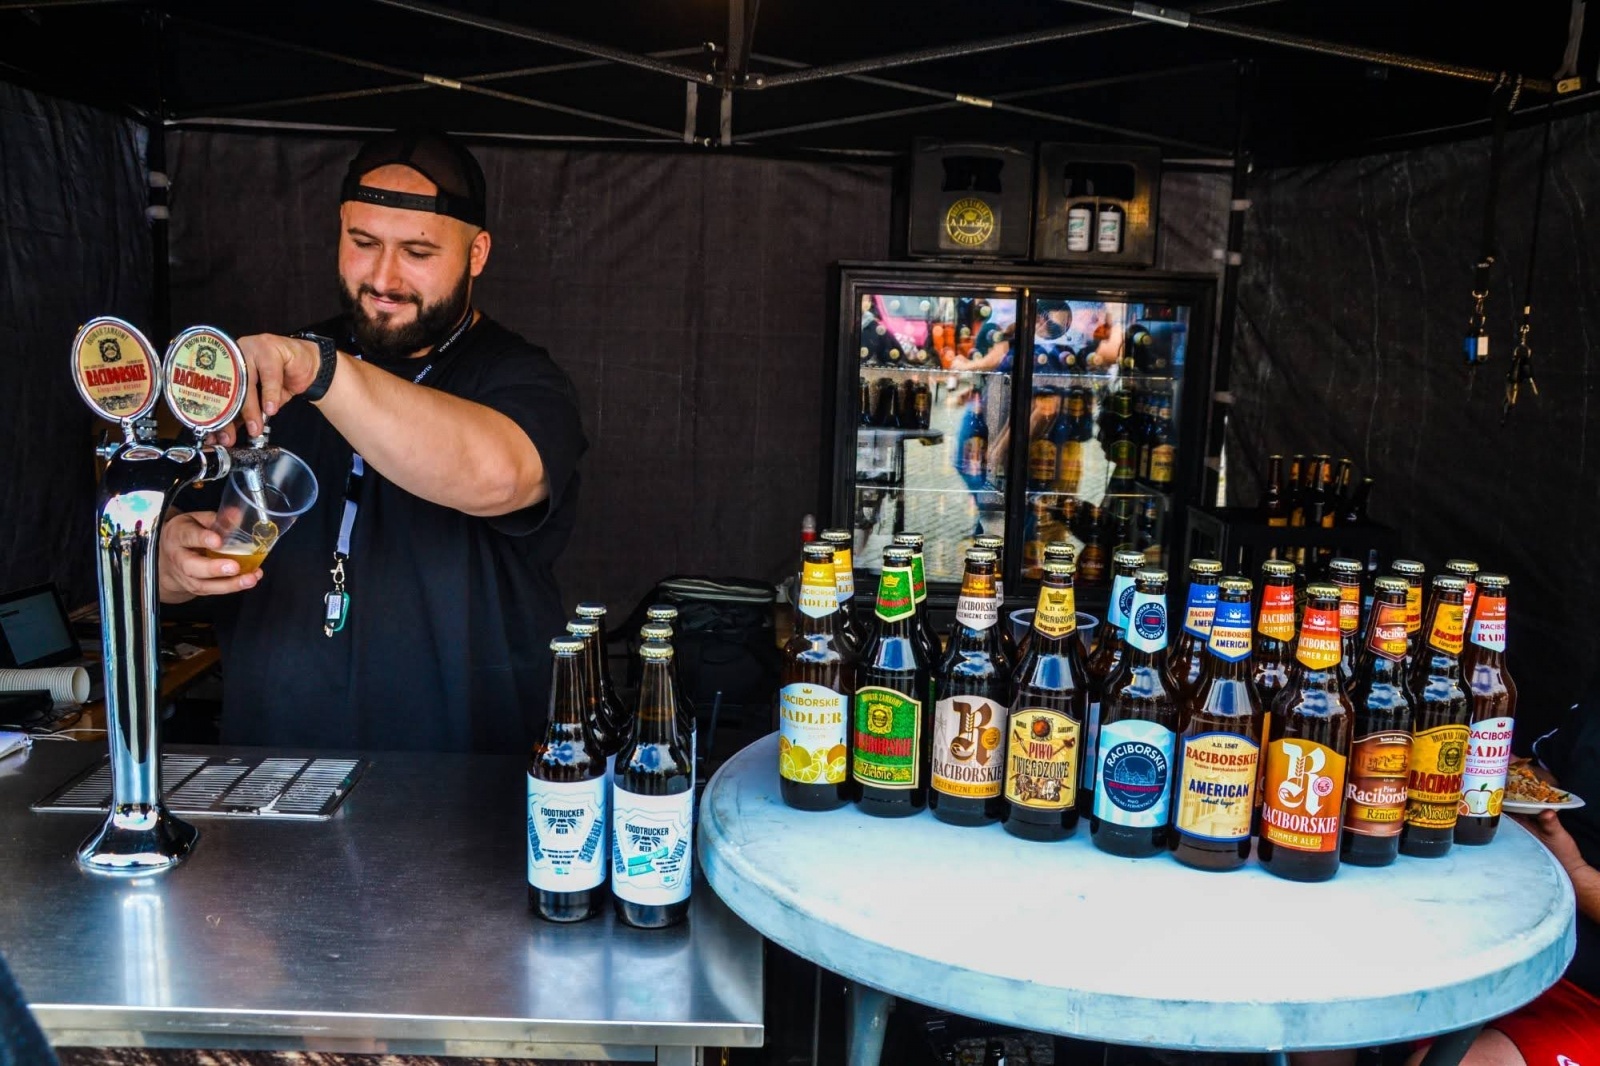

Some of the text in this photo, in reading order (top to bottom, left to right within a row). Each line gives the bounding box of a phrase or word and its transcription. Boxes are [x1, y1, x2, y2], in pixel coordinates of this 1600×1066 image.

[173, 367, 231, 399] RACIBORSKIE
[781, 705, 842, 724] RADLER
[1028, 742, 1053, 760] PIWO
[1106, 744, 1166, 772] RACIBORSKIE
[1186, 746, 1257, 766] RACIBORSKIE
[863, 762, 892, 780] Zielone
[934, 758, 1002, 783] RACIBORSKIE
[1013, 755, 1070, 778] TWIERDZOWE
[1189, 779, 1249, 798] AMERICAN
[1347, 783, 1408, 804] Raciborski
[541, 807, 585, 817] FOODTRUCKER
[1262, 802, 1338, 834] RACIBORSKIE
[625, 823, 669, 835] FOODTRUCKER
[1270, 829, 1298, 844] SUMMER
